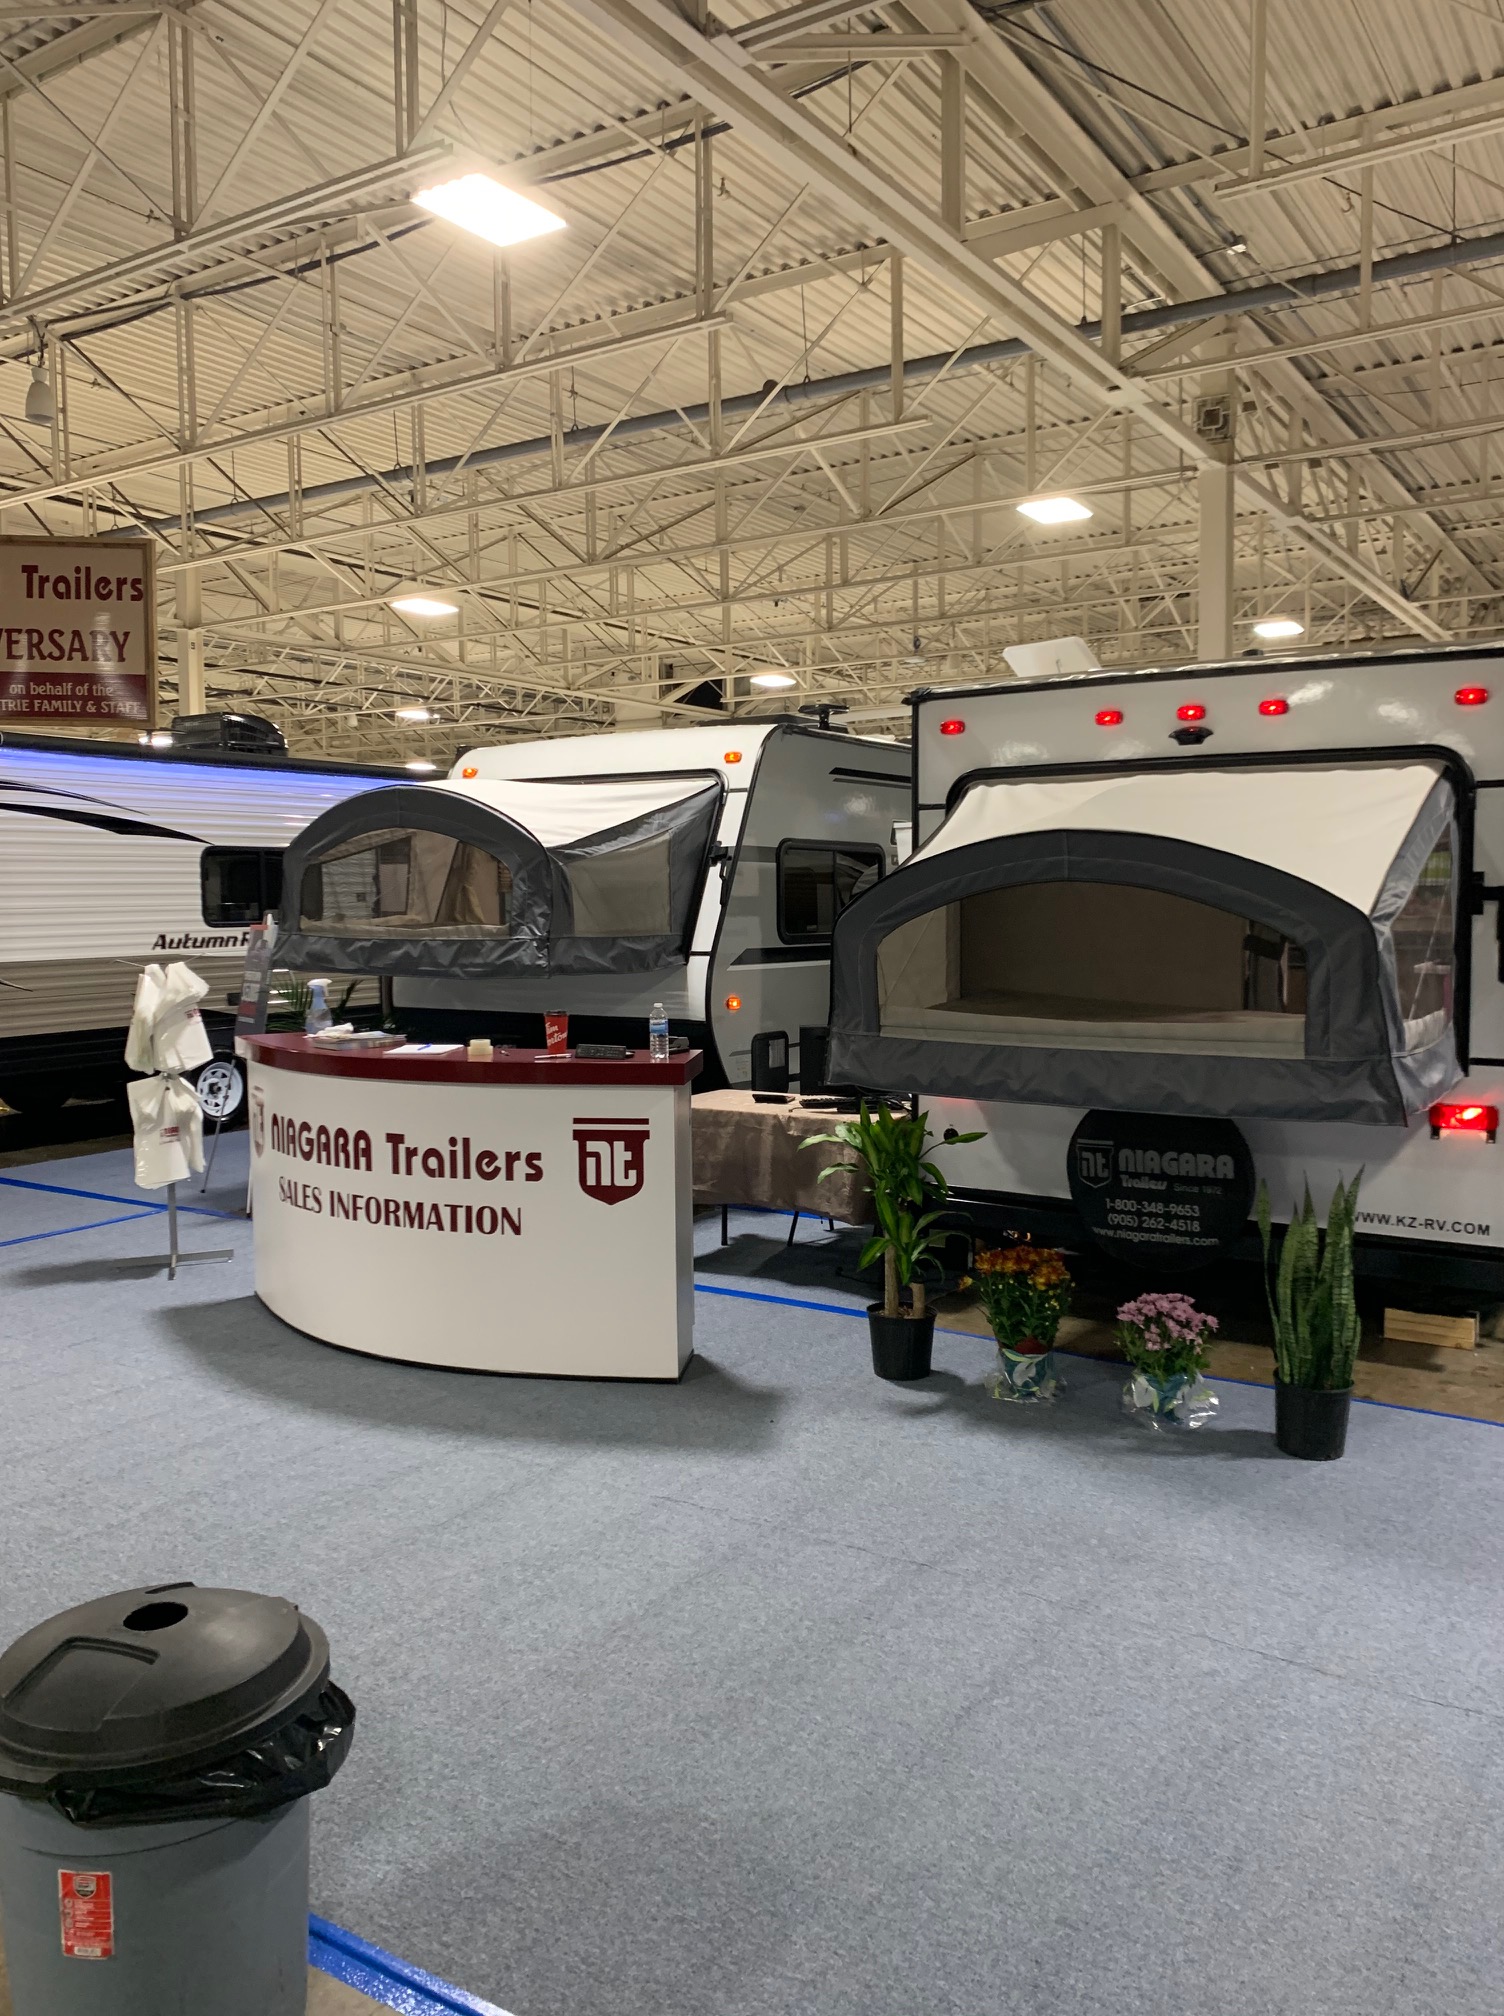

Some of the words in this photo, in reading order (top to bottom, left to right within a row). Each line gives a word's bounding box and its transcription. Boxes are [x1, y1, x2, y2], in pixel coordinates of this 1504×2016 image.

[21, 565, 144, 602] Trailers
[0, 628, 130, 662] ERSARY
[9, 684, 26, 695] on
[30, 682, 72, 696] behalf
[75, 683, 90, 696] of
[92, 684, 114, 697] the
[34, 700, 82, 713] FAMILY
[86, 701, 97, 713] &
[100, 701, 142, 714] STAFF
[152, 933, 238, 950] Autumn
[271, 1112, 373, 1172] NIAGARA
[385, 1132, 544, 1182] Trailers
[1118, 1148, 1235, 1179] NIAGARA
[278, 1175, 323, 1214] SALES
[328, 1190, 521, 1236] INFORMATION
[1105, 1198, 1200, 1217] 1-800-348-9653
[1107, 1214, 1139, 1229] (905)
[1142, 1216, 1200, 1232] 262-4518
